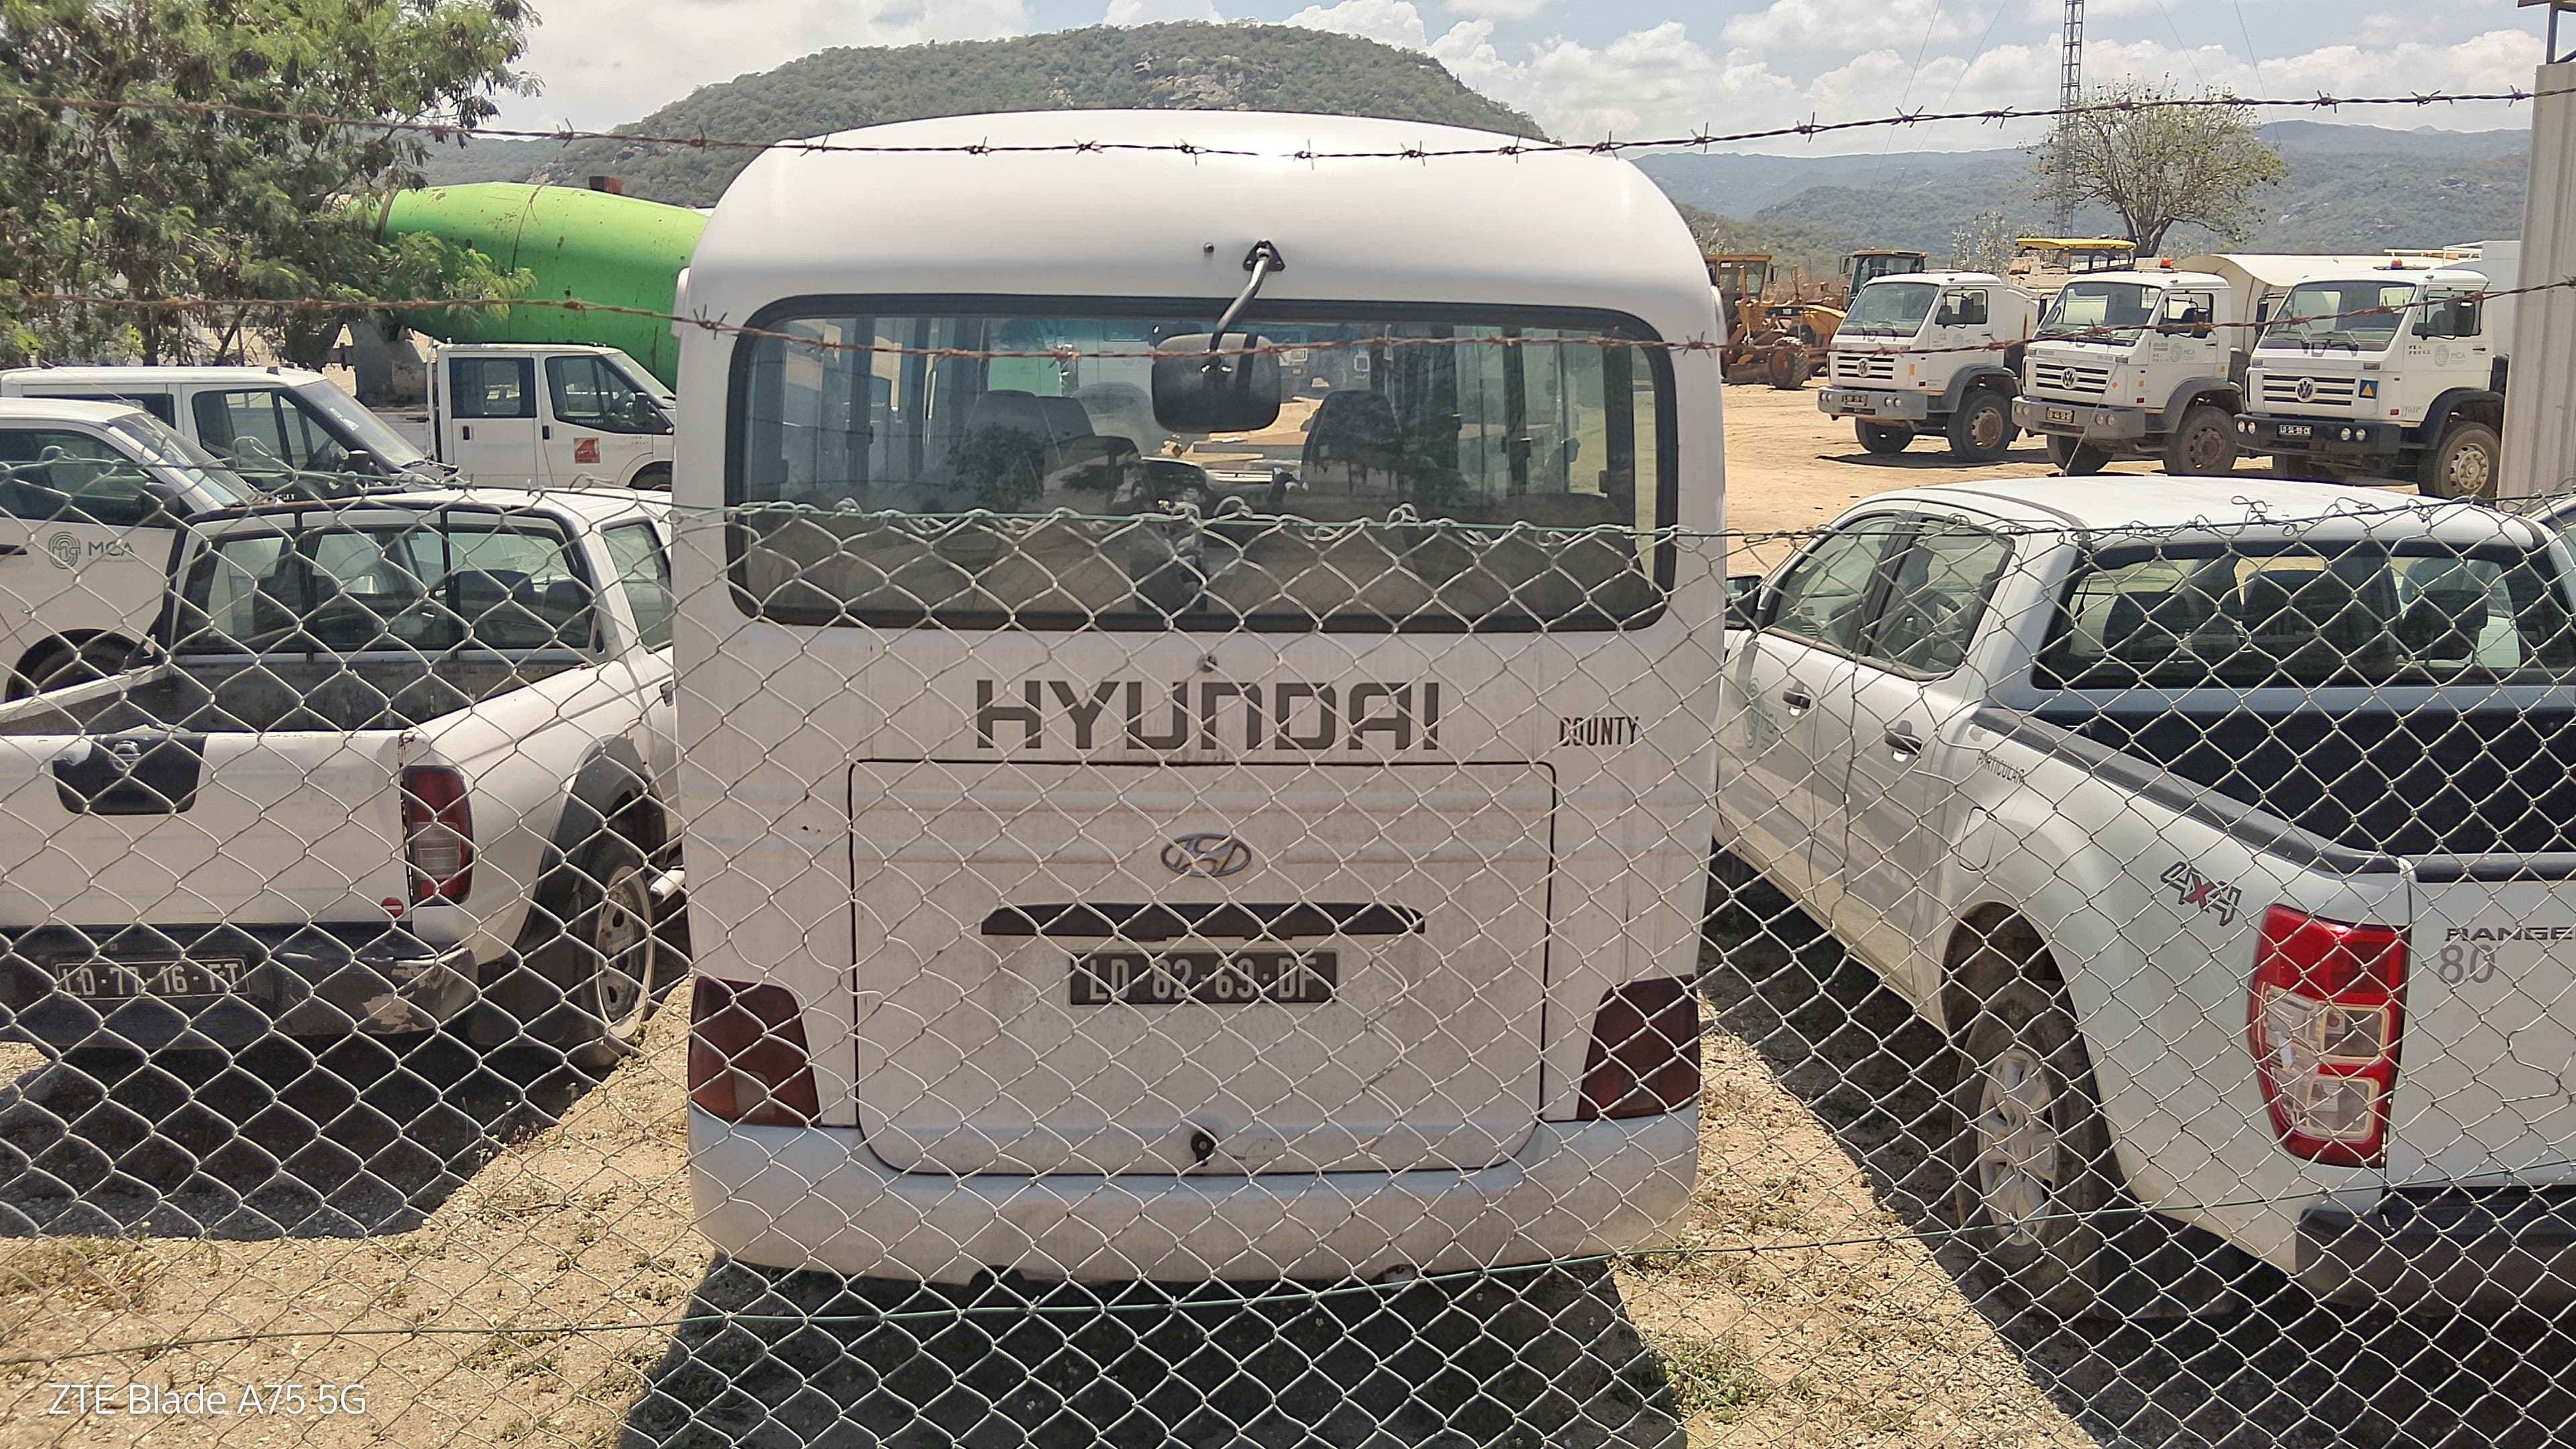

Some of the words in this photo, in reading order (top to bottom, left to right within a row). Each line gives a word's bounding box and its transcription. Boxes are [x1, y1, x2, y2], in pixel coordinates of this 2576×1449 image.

[89, 541, 134, 557] MCA
[977, 680, 1440, 750] HYUNDAI
[1559, 716, 1639, 747] COUNTY
[2445, 927, 2576, 941] RANGE
[2438, 944, 2496, 983] 80
